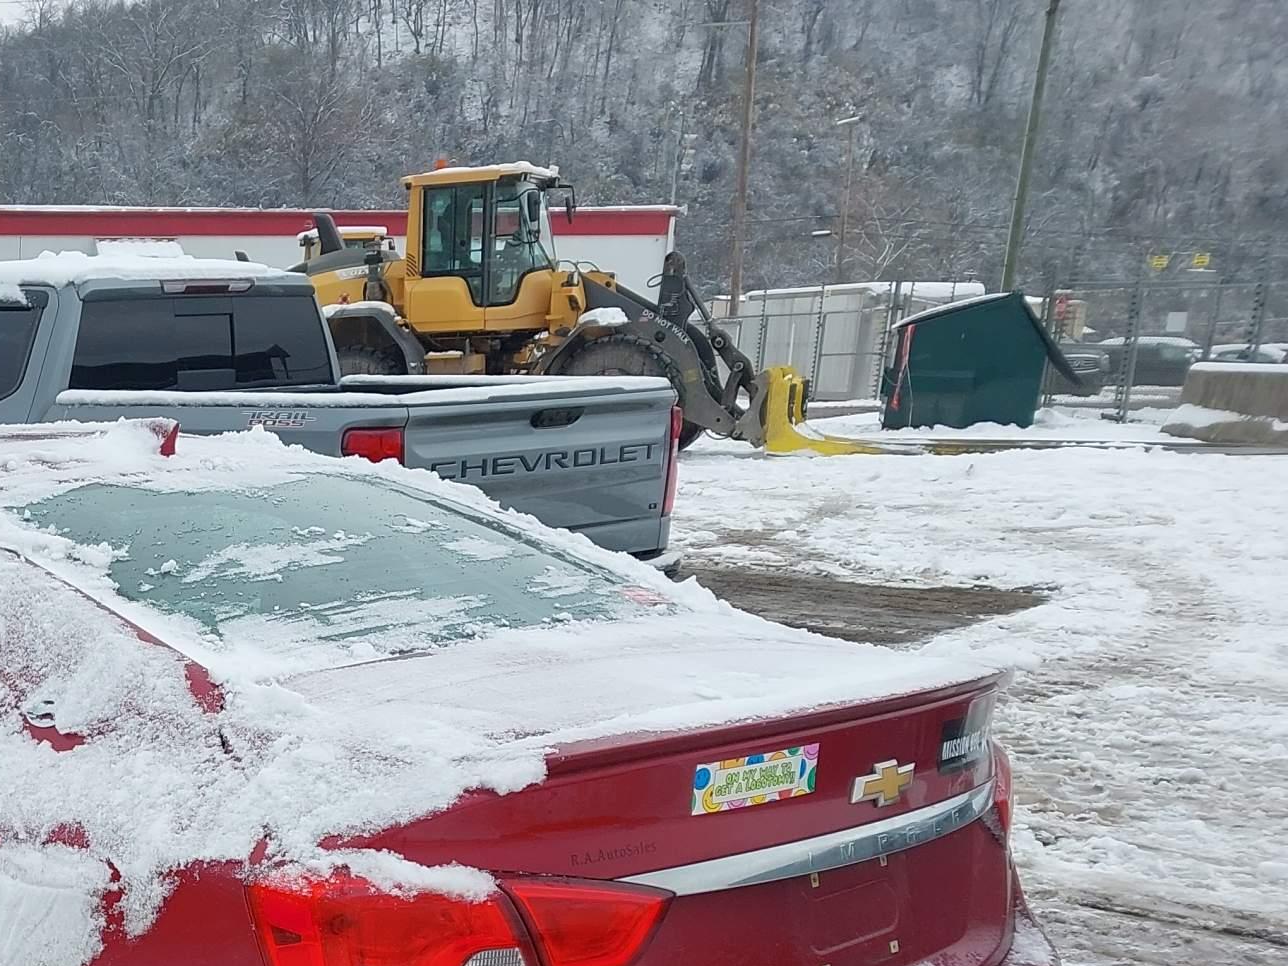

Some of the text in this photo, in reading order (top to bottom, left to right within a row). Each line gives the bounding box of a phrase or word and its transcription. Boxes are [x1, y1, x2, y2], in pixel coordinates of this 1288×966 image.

[642, 309, 691, 345] DO NOT WALK
[241, 408, 317, 422] TRAIL
[247, 418, 307, 430] BOSS
[430, 442, 659, 480] CHEVROLET
[726, 771, 740, 786] ON
[742, 768, 757, 781] MY
[714, 783, 732, 798] GET
[735, 782, 743, 794] A
[806, 808, 962, 868] IMPALA
